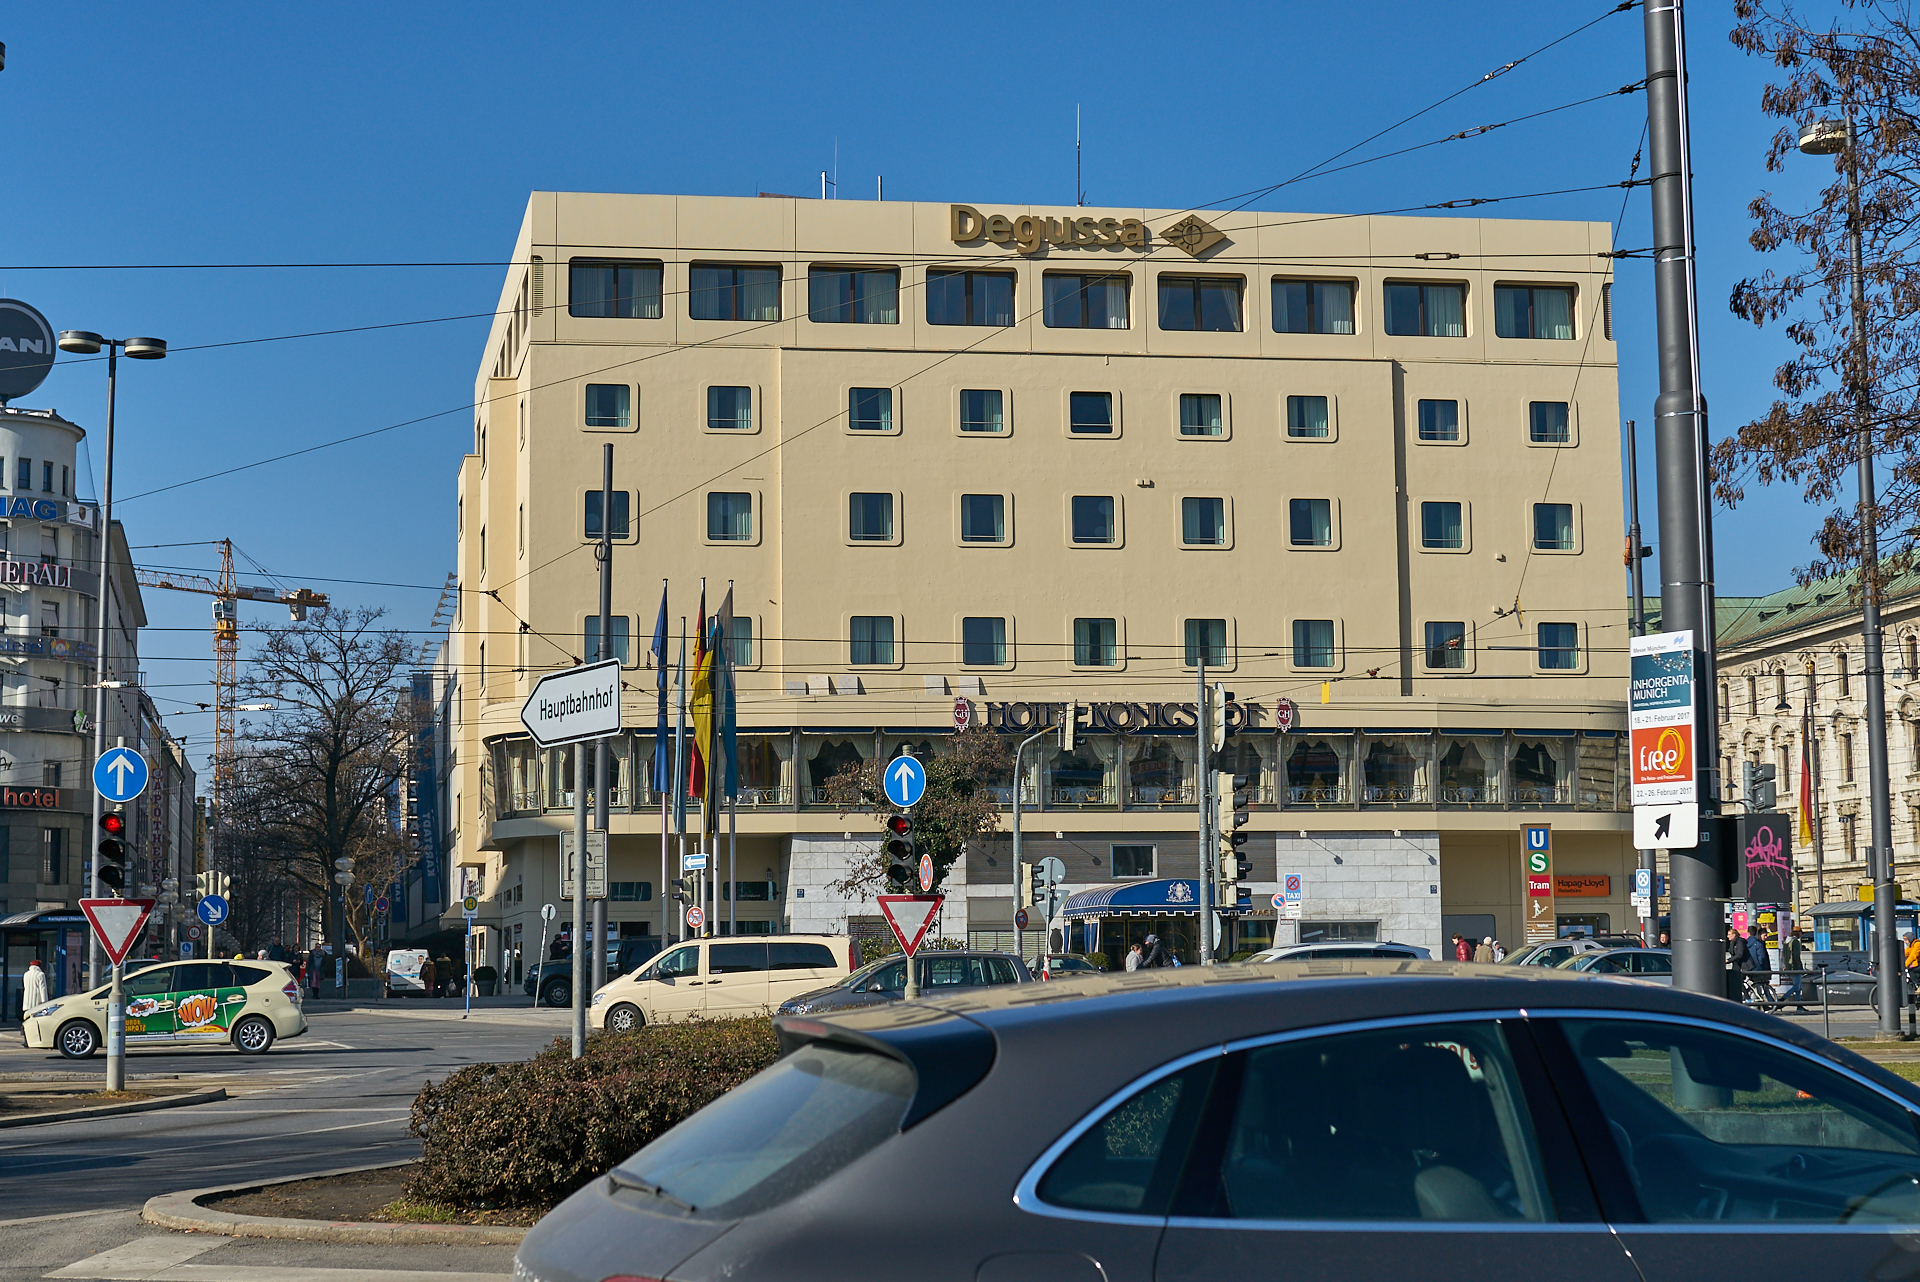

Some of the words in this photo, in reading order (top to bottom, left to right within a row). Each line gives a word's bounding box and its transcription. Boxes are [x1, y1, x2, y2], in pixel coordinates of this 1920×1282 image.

[951, 204, 1145, 254] Degussa
[1633, 674, 1690, 690] INHORGENTA
[1633, 687, 1668, 701] MUNICH
[540, 684, 614, 722] Hauptbahnhof
[1088, 701, 1261, 734] KÖNIGSOF
[1653, 714, 1676, 722] Februar
[1677, 712, 1690, 720] 2017
[4, 787, 60, 808] hotel
[1656, 788, 1679, 796] Februar
[1679, 786, 1693, 795] 2017
[152, 780, 164, 884] APOTHEKE
[1531, 830, 1545, 849] U
[1531, 853, 1547, 873] S
[1529, 880, 1551, 893] Tram
[1557, 879, 1604, 889] Hapag-Lloyd
[467, 899, 475, 908] H
[1286, 892, 1301, 900] TAXI
[177, 996, 218, 1024] WOW
